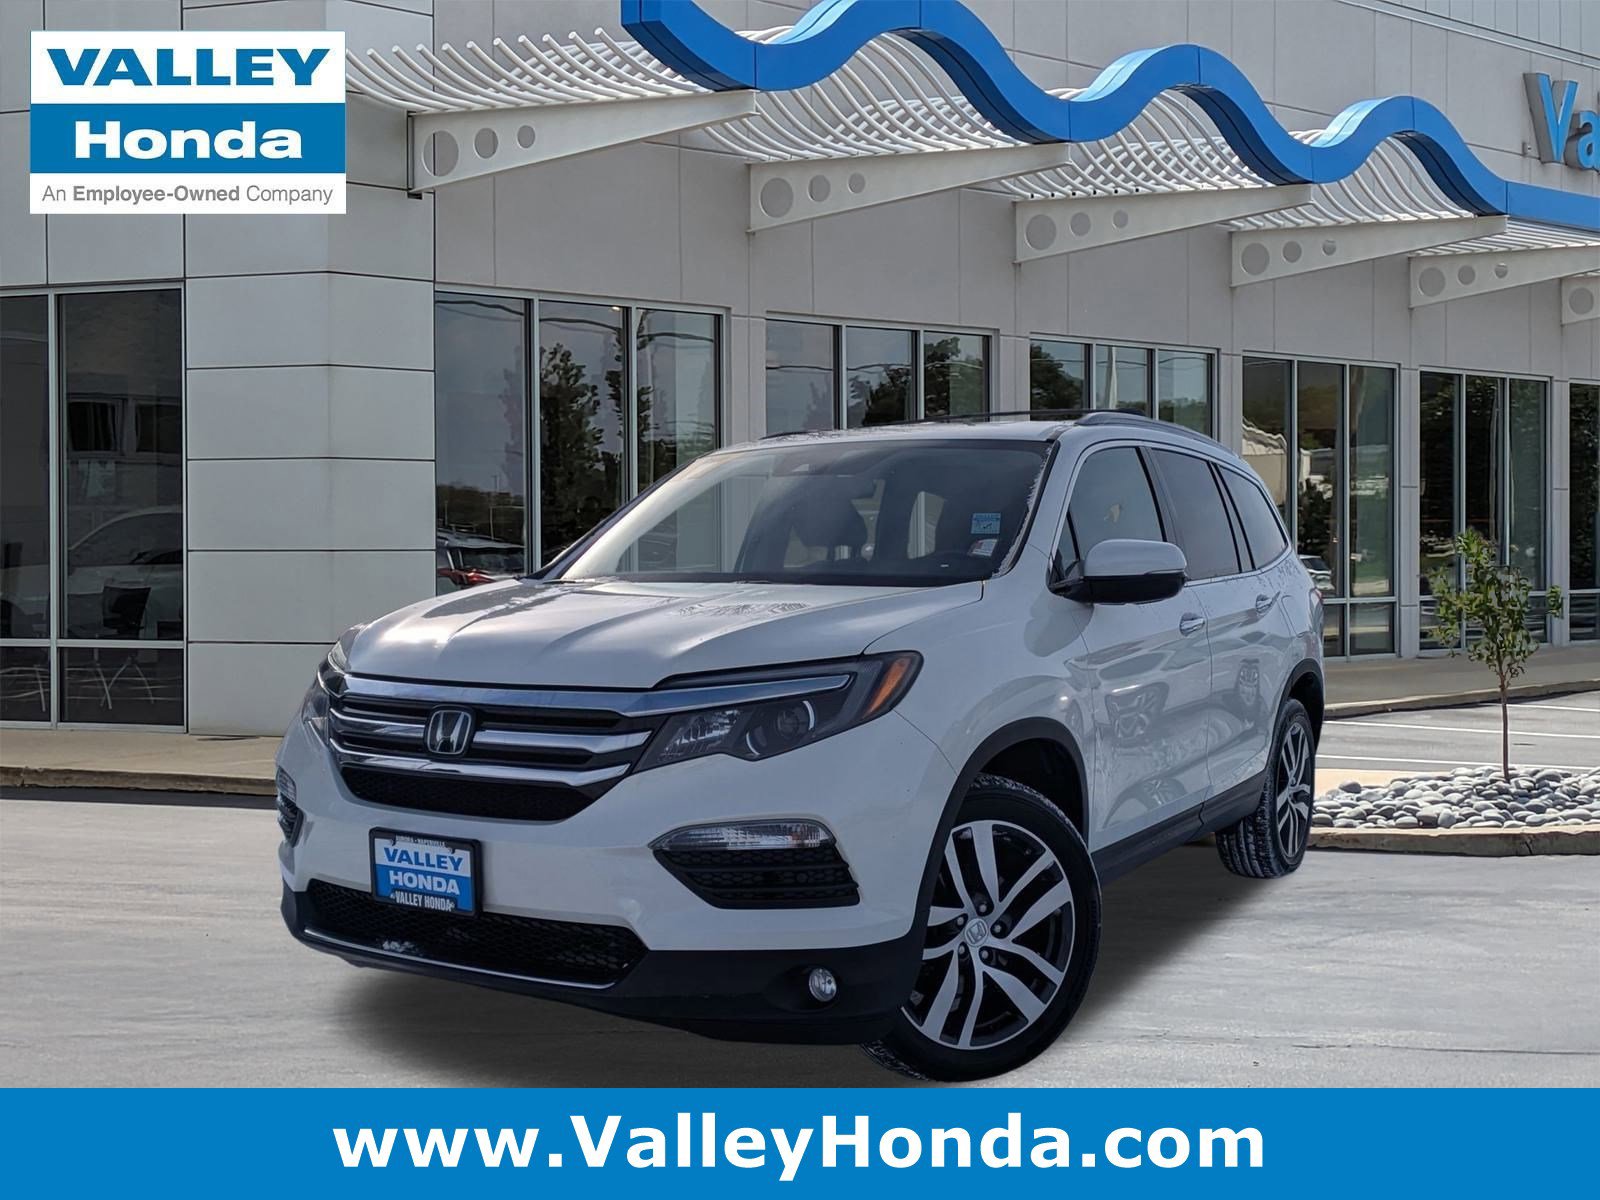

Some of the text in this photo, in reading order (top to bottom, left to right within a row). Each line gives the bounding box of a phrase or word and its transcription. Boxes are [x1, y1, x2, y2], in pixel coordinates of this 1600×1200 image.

[384, 847, 464, 872] VALLEY
[389, 870, 460, 895] HONDA
[395, 891, 453, 912] VALLEY HONDA
